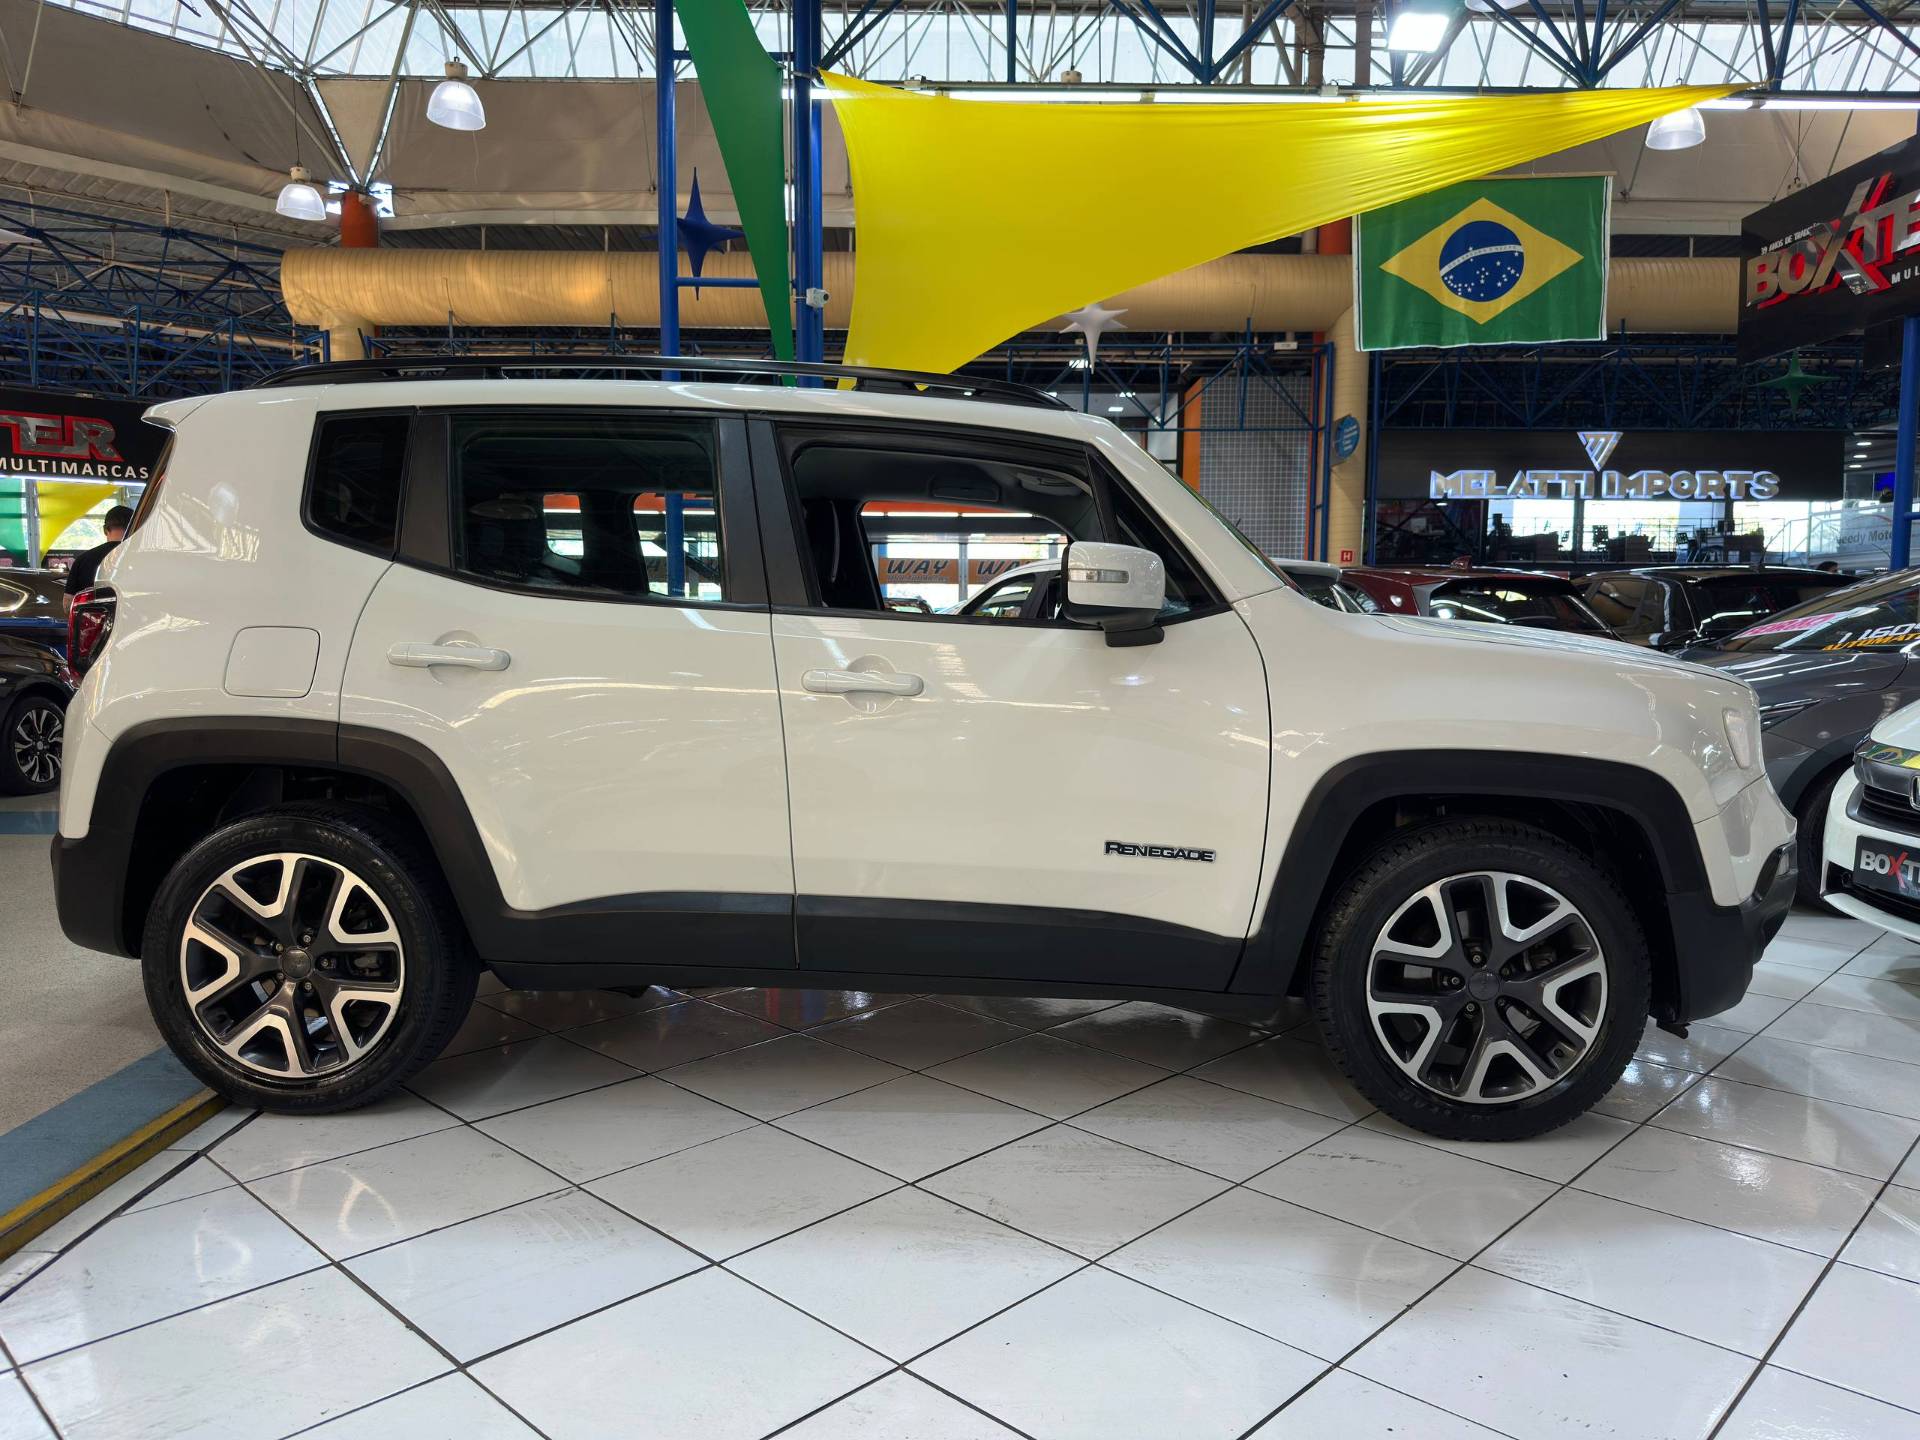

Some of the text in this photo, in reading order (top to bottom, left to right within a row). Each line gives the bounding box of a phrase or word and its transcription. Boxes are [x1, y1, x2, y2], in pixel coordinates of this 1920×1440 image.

[1430, 470, 1780, 500] MELATTI IMPORTS
[887, 559, 949, 575] WAY
[977, 560, 1029, 575] WA
[1104, 841, 1216, 863] RENEGADE
[1860, 849, 1920, 889] BOXT
